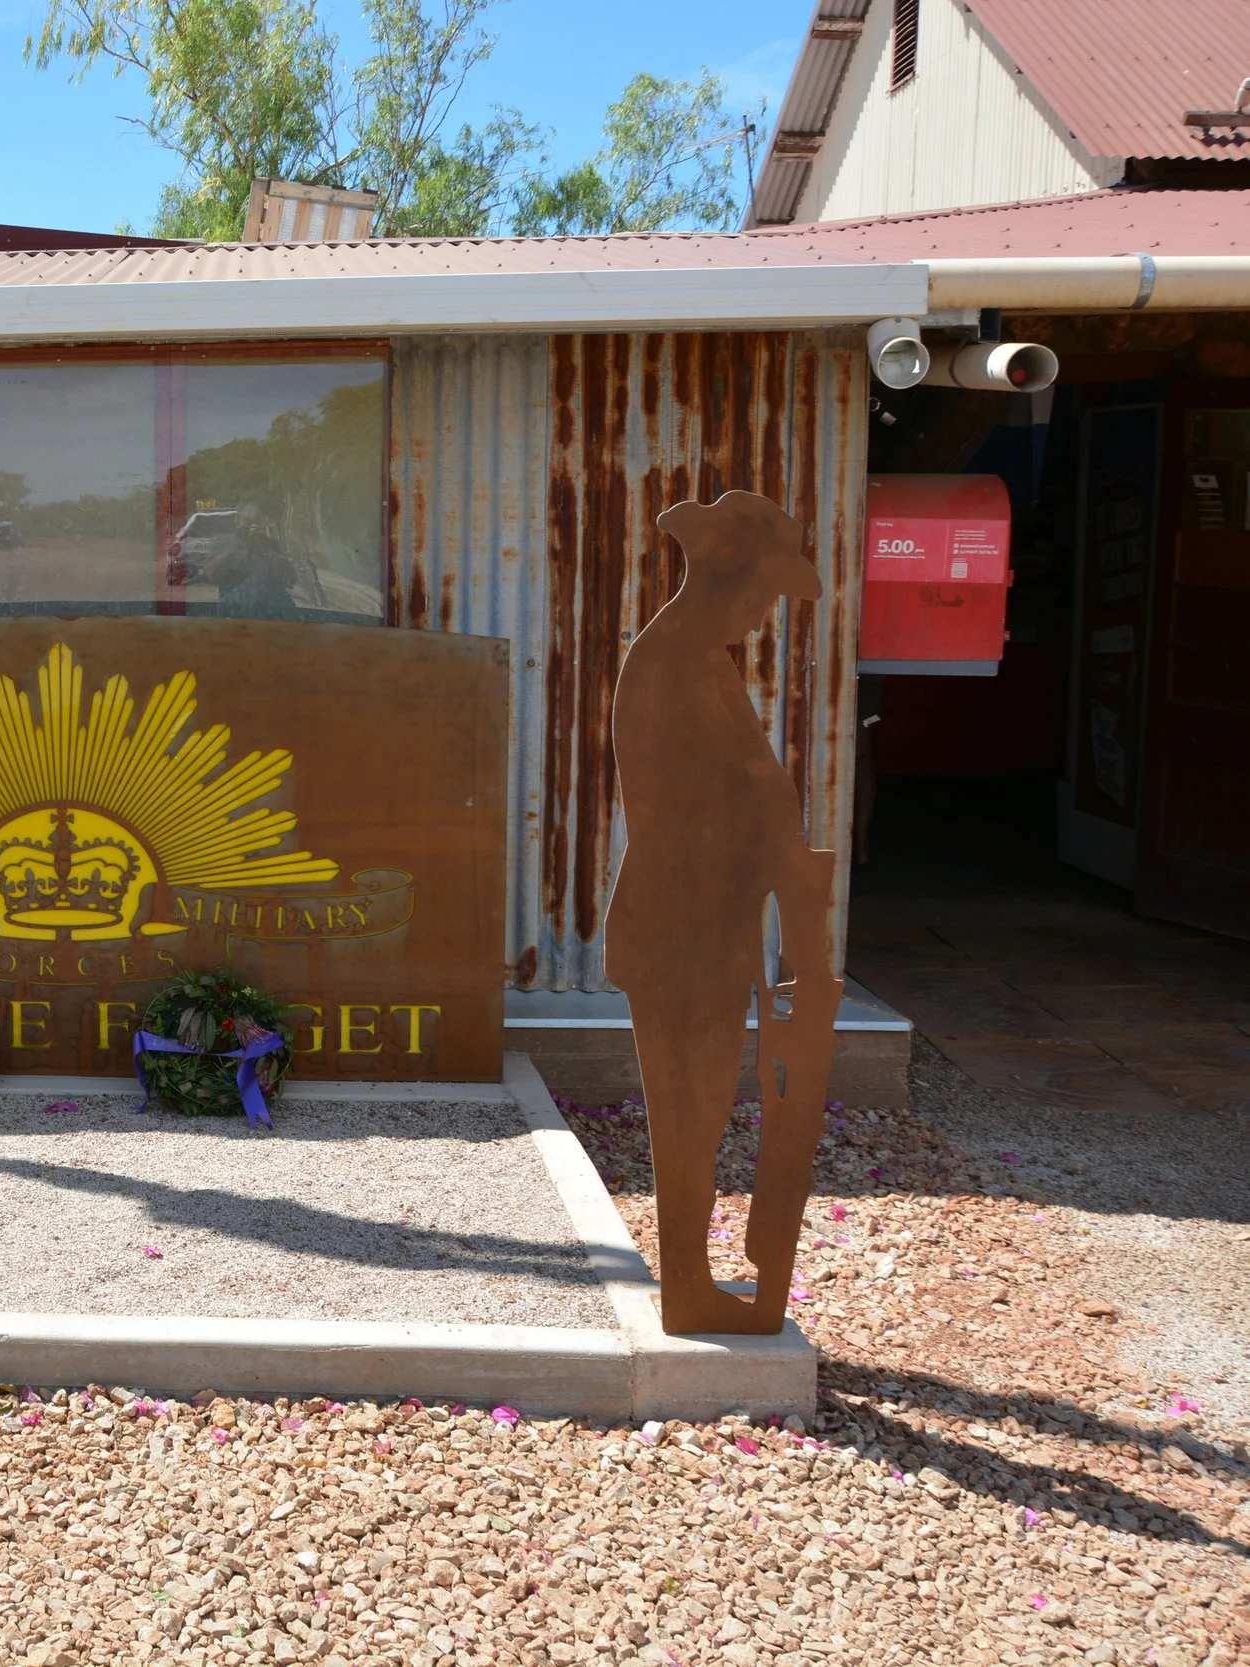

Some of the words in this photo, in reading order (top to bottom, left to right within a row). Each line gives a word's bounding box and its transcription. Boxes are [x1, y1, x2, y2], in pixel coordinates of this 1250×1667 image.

[877, 539, 915, 554] 5.00
[174, 896, 374, 930] MILITARY
[95, 1001, 442, 1055] FGET
